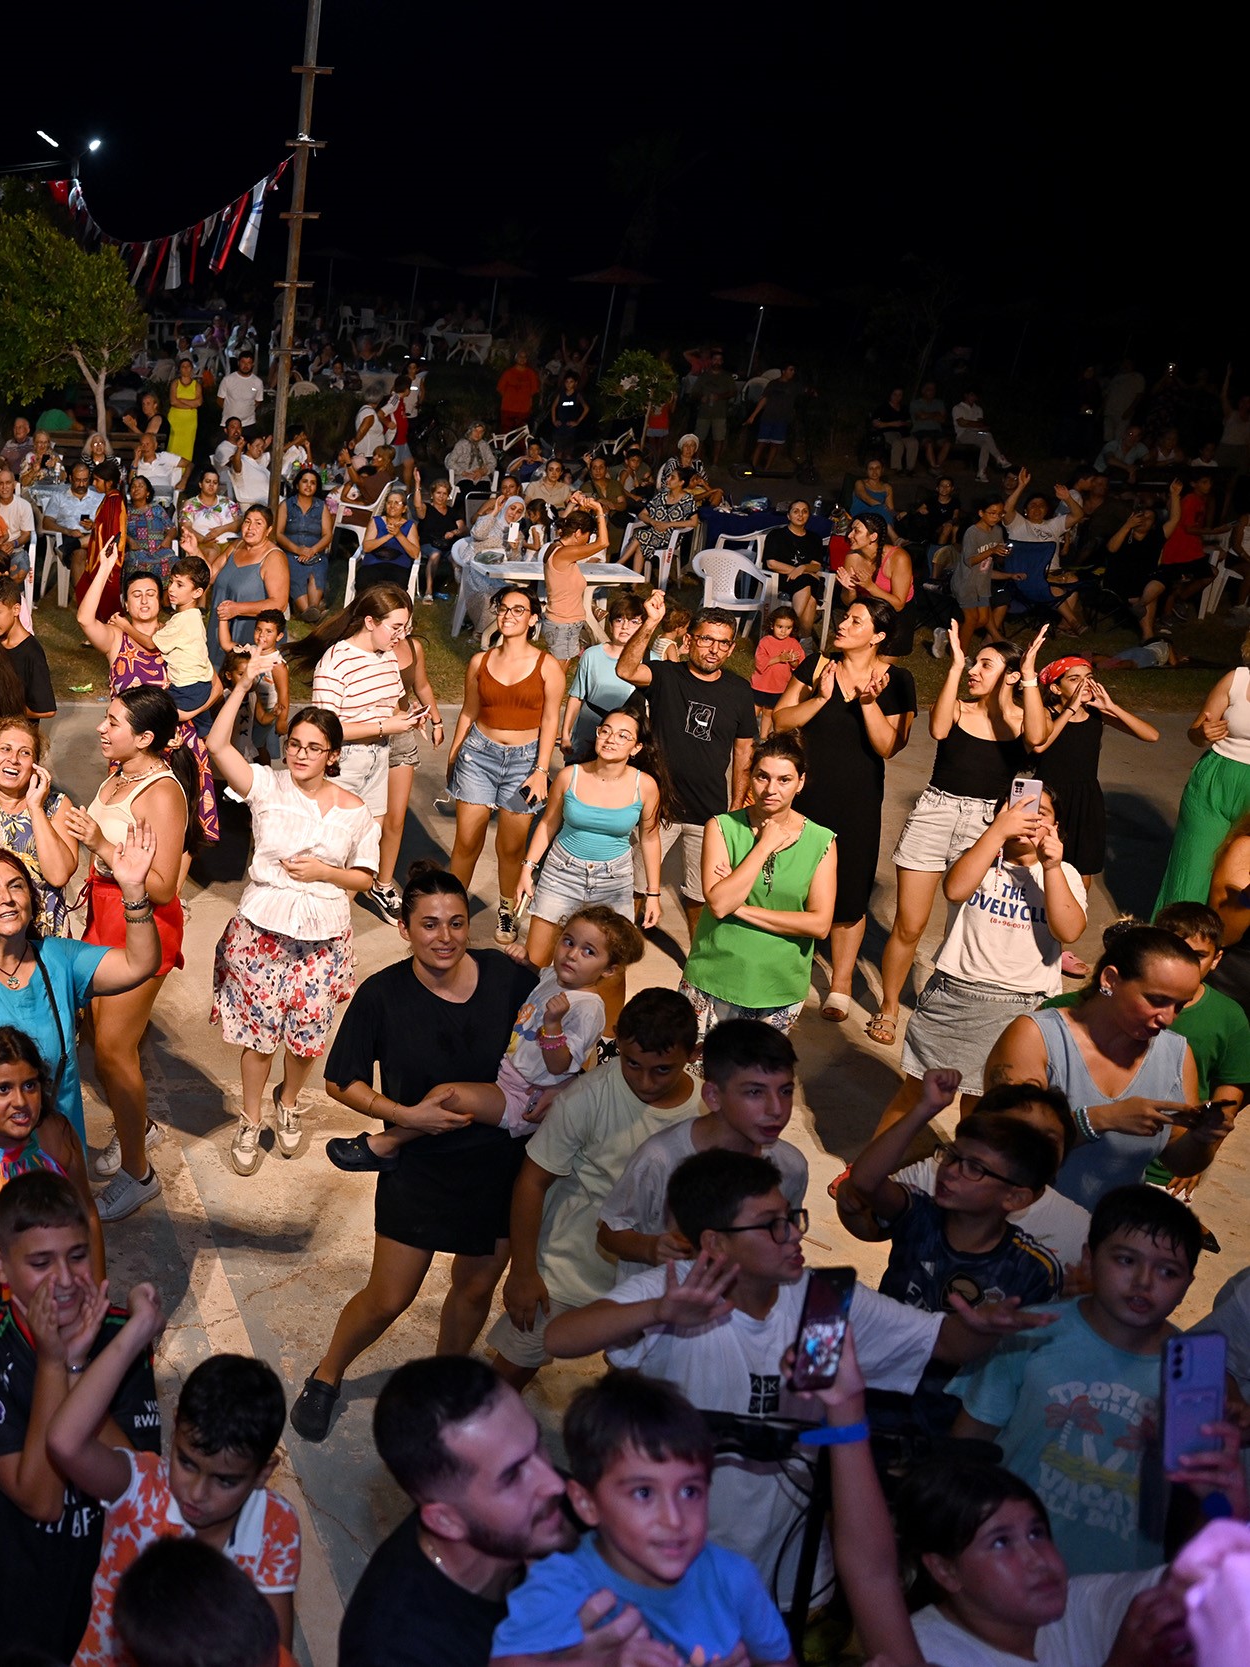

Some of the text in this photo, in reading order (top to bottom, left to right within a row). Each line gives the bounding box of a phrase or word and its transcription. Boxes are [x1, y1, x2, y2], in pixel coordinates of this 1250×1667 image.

[968, 892, 1047, 924] OVELY CLU
[1002, 883, 1026, 901] THE
[1047, 1380, 1157, 1418] TROPIC
